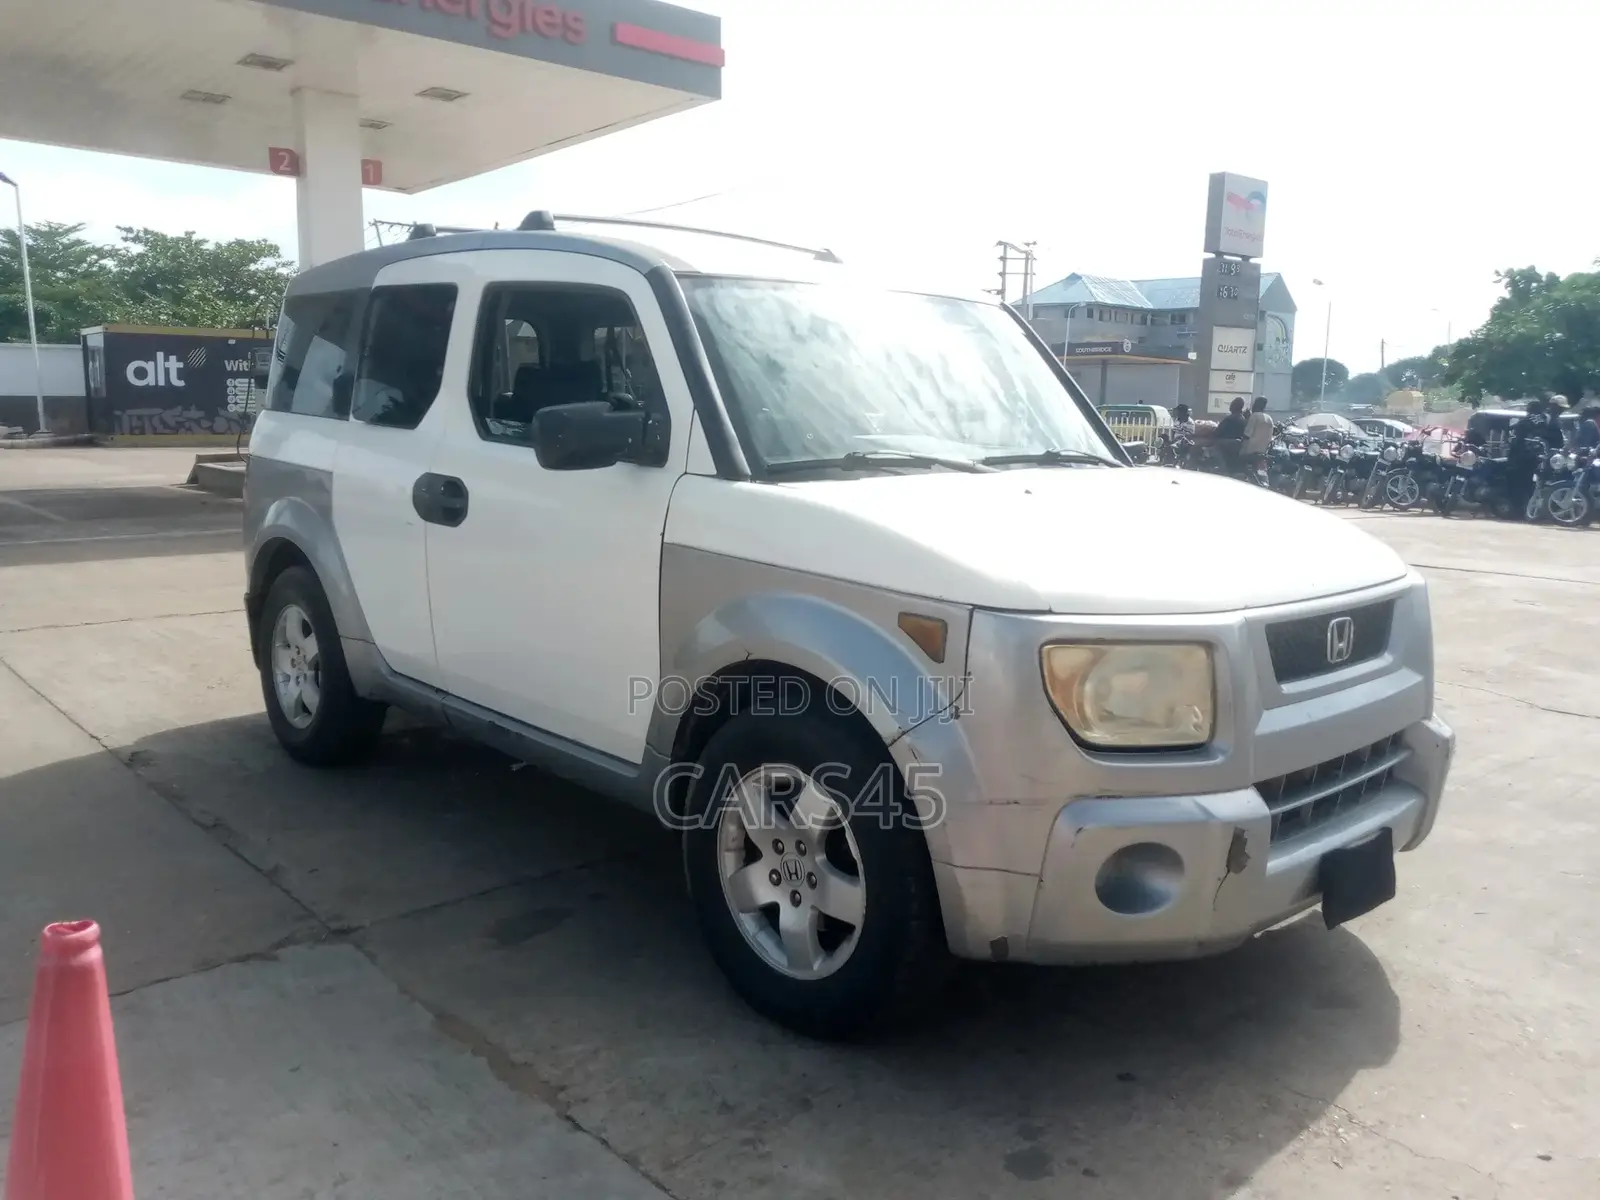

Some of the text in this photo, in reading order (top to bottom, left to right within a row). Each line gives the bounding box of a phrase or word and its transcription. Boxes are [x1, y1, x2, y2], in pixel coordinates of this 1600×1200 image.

[278, 151, 292, 172] 2
[364, 163, 375, 183] 1
[1075, 346, 1113, 354] SOUTHBRIDGE
[1217, 344, 1248, 354] QUARTZ
[126, 351, 186, 387] alt
